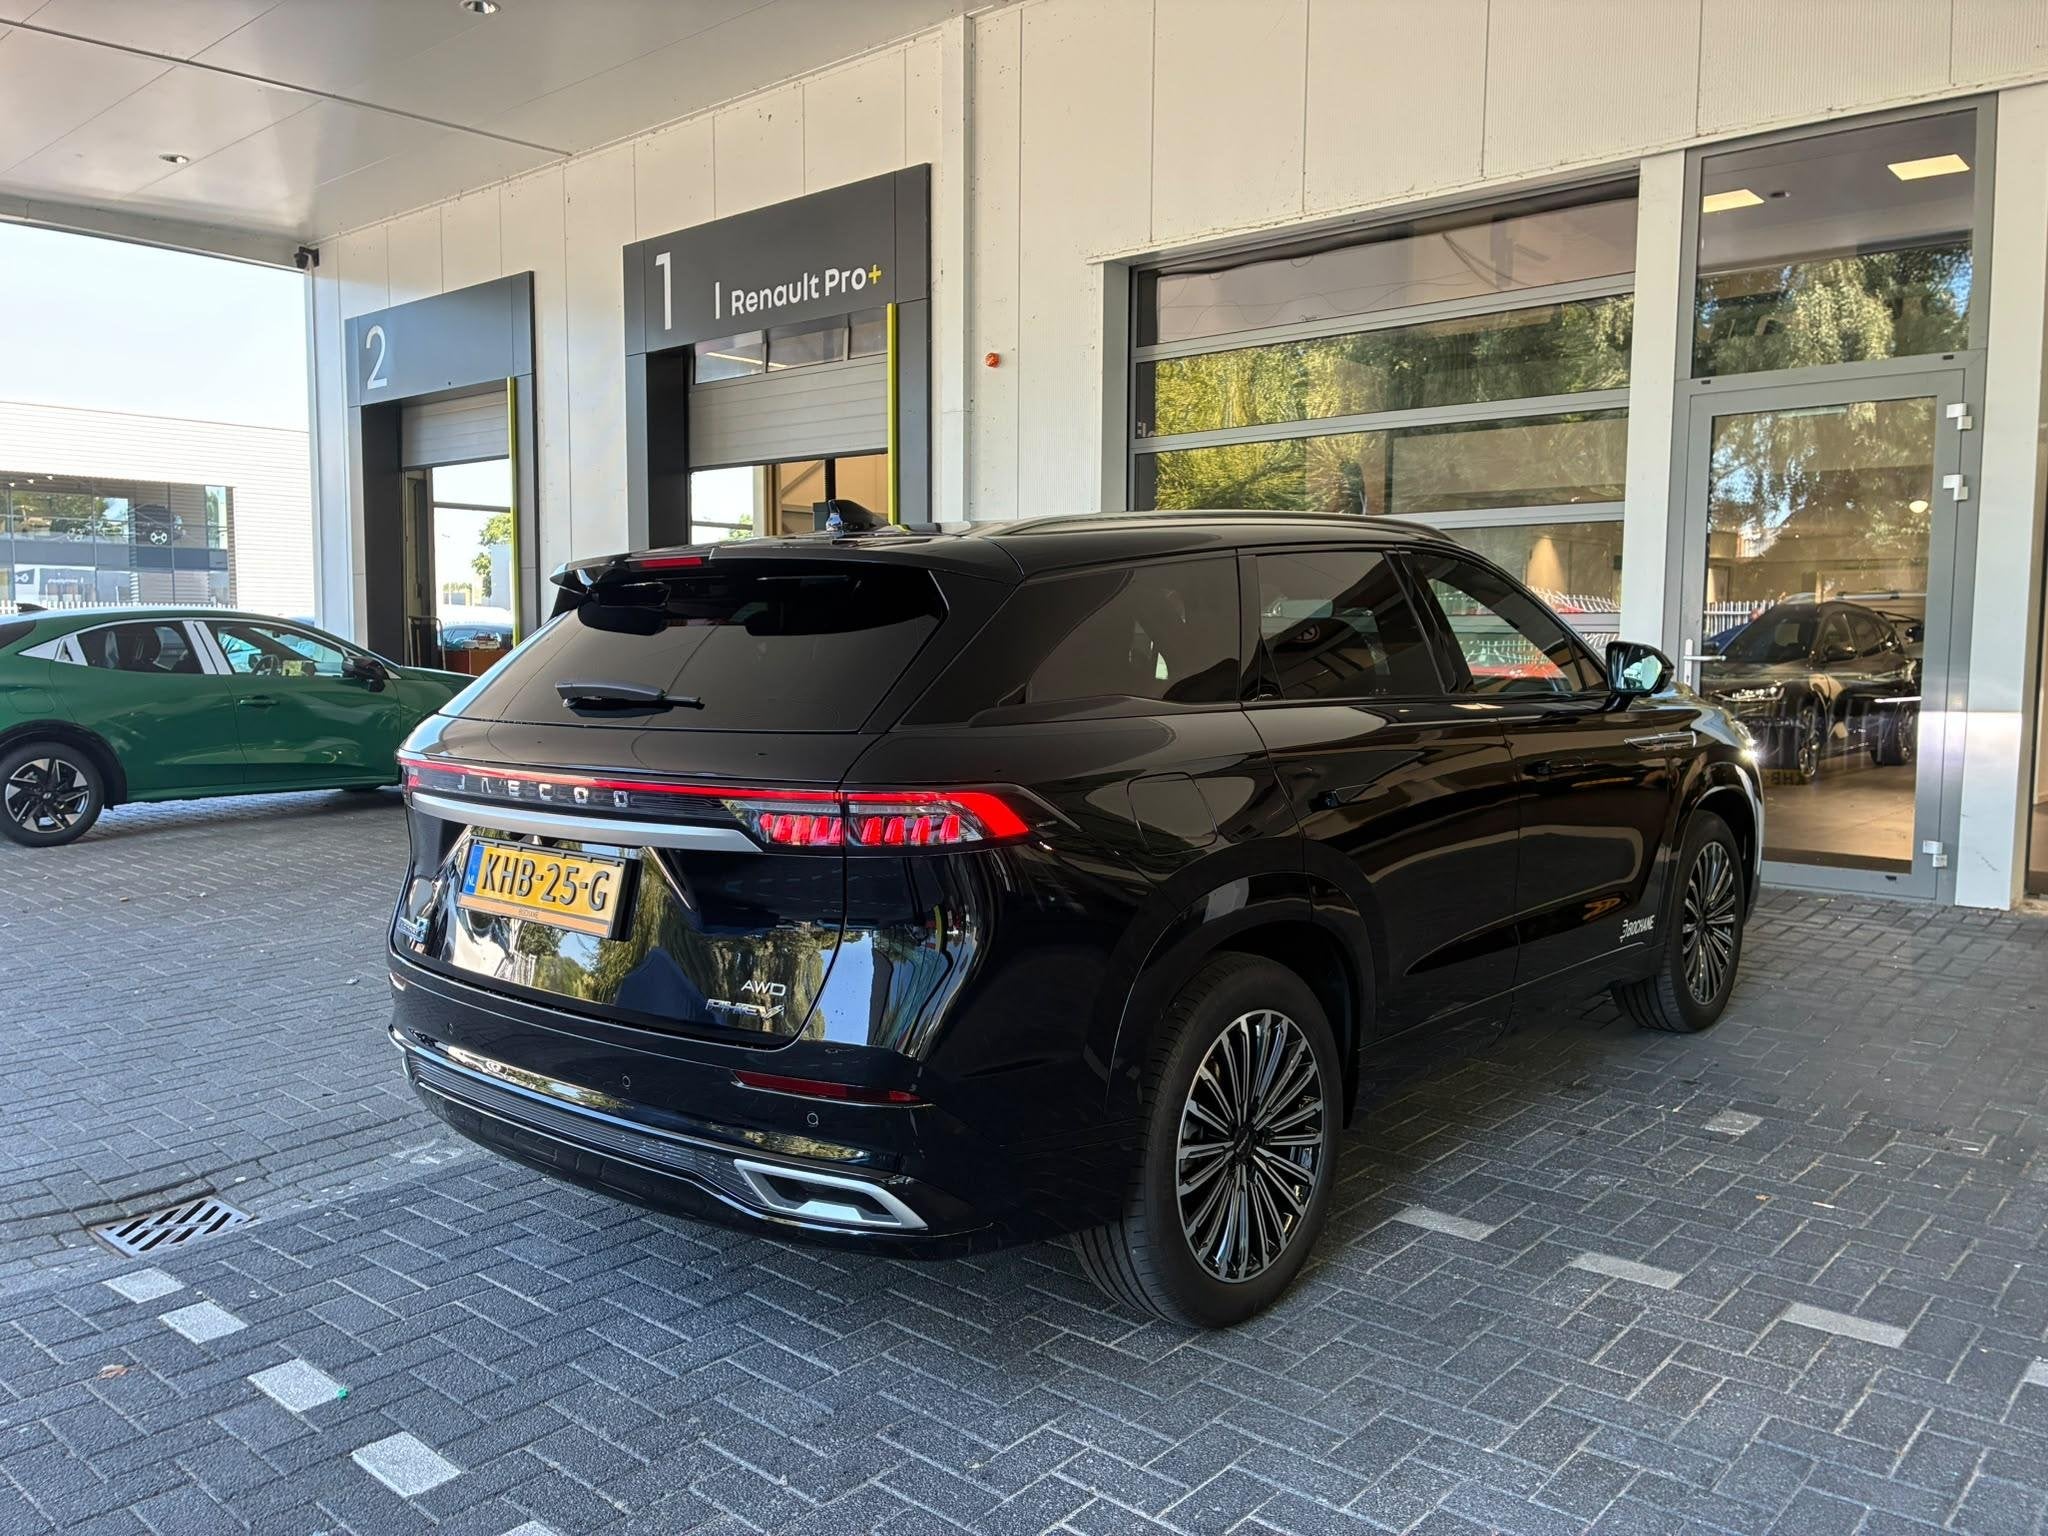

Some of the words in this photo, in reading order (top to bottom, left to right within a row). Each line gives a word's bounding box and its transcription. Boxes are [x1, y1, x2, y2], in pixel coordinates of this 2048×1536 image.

[655, 252, 672, 331] 1
[731, 273, 820, 316] Renault
[824, 264, 882, 296] Pro+
[365, 325, 388, 390] 2
[481, 853, 610, 912] KHB-25-G
[741, 979, 786, 997] AWD
